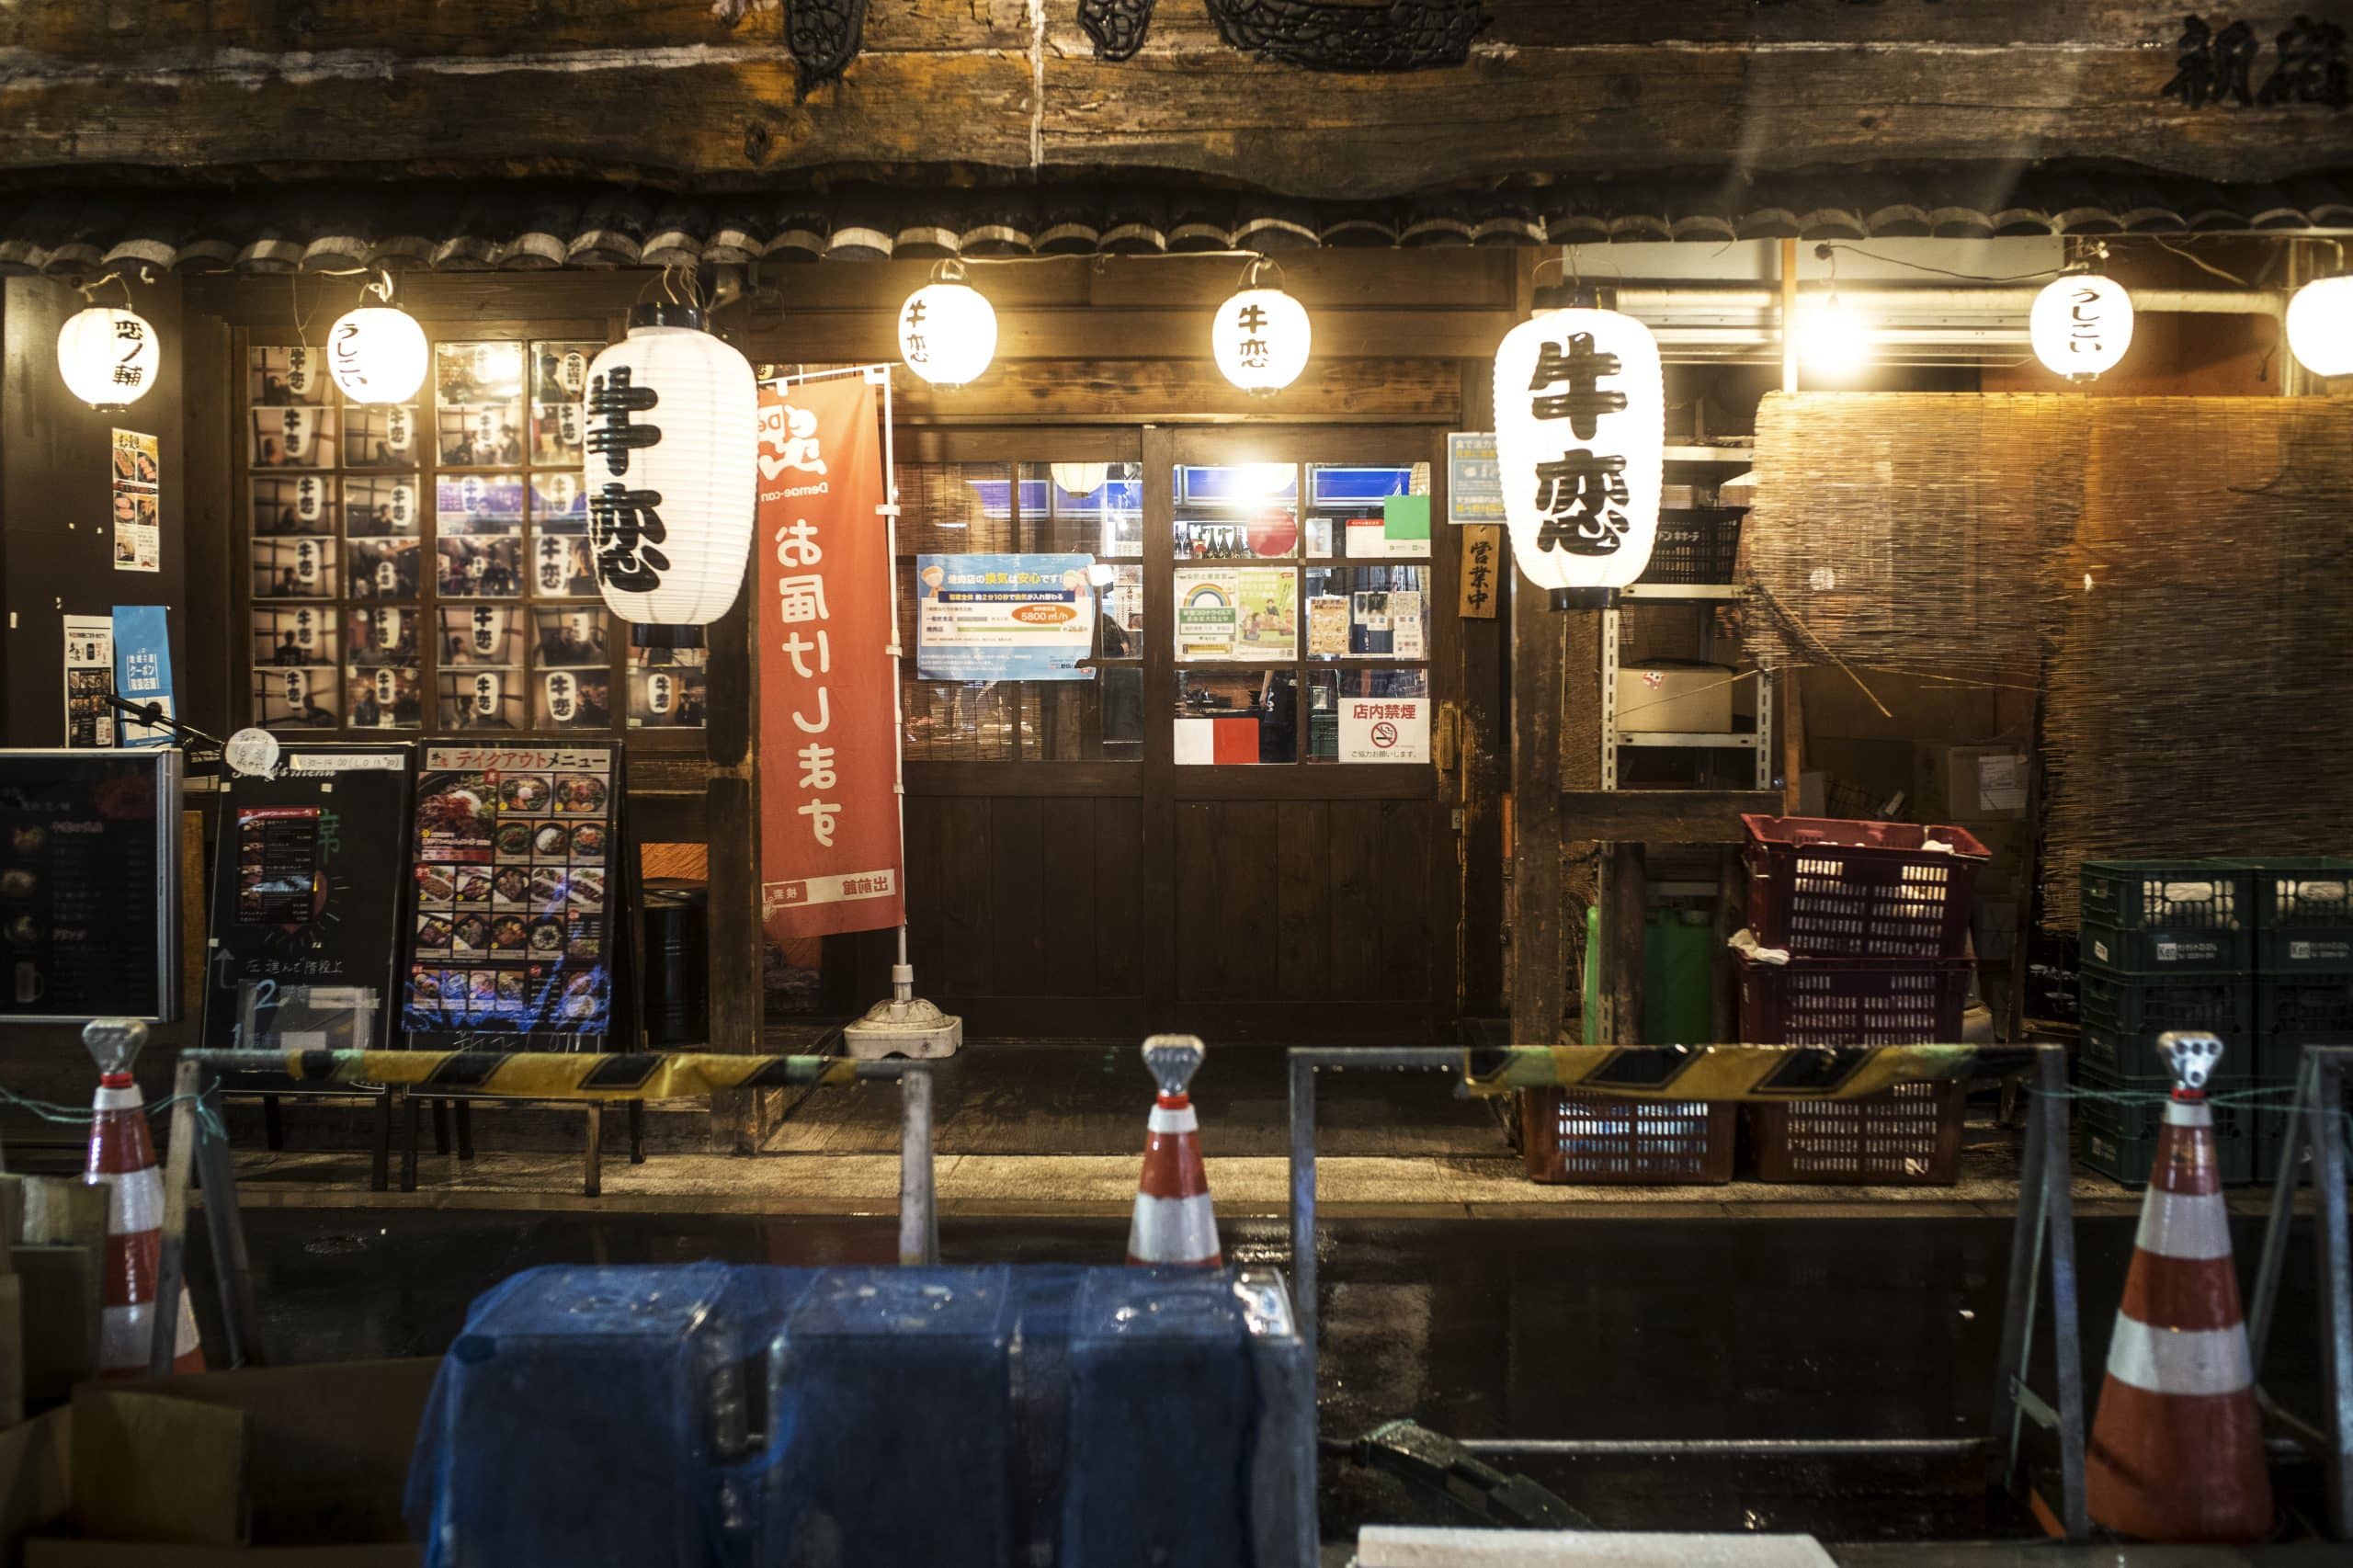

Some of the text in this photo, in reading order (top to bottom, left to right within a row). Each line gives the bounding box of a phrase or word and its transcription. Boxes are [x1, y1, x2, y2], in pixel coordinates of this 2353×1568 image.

[905, 300, 929, 363] 牛恋
[1238, 304, 1269, 368] 牛恋
[2070, 288, 2102, 353] うしこい
[337, 323, 368, 387] うしこい
[1529, 332, 1629, 556] 牛恋
[586, 365, 670, 593] 牛恋
[1468, 541, 1492, 610] 営業中
[130, 665, 154, 676] クーポン
[1353, 704, 1416, 720] 店内禁煙
[456, 752, 607, 768] テイクアウトメニュー
